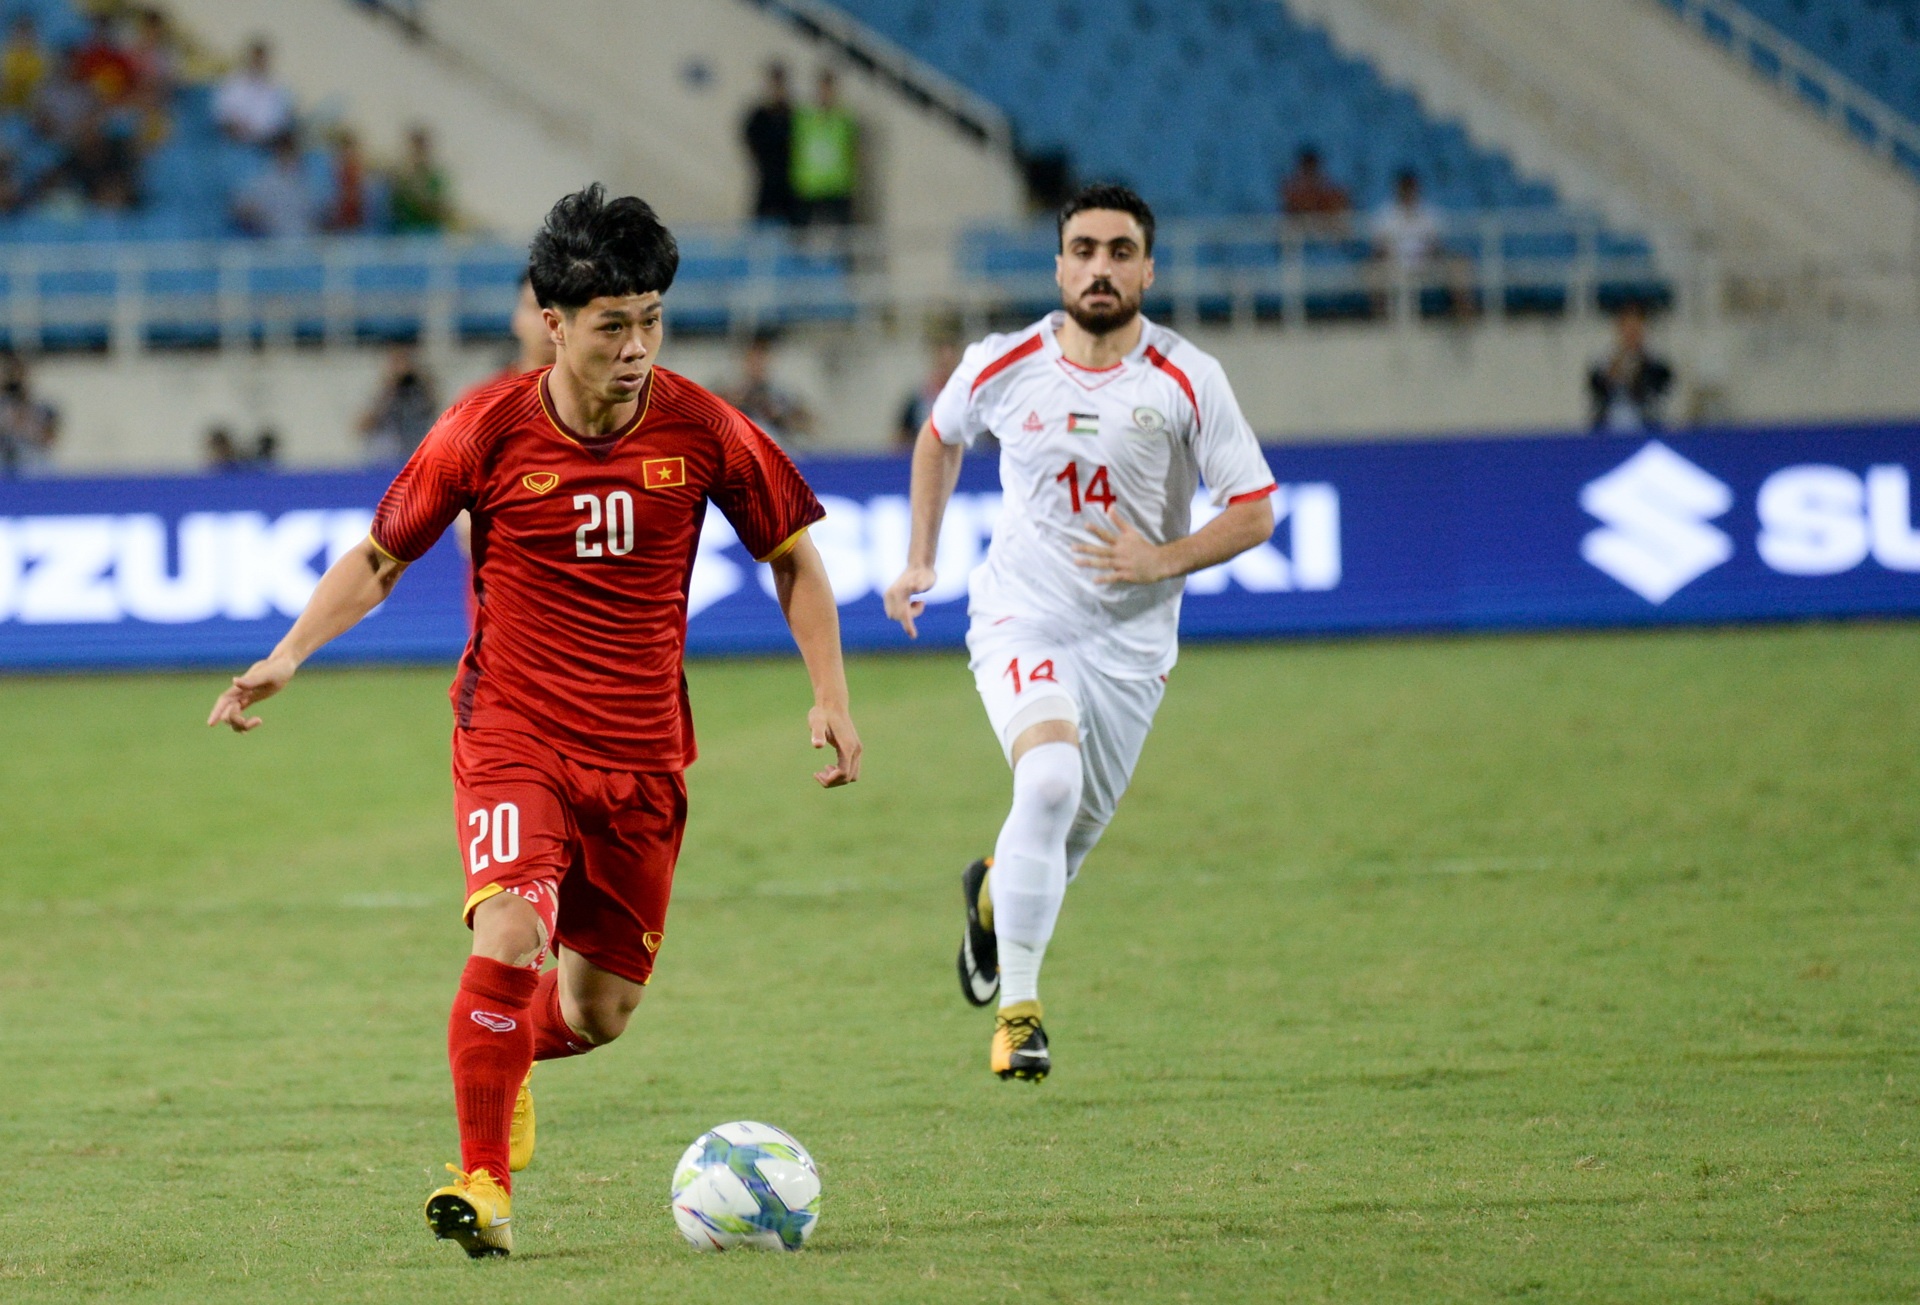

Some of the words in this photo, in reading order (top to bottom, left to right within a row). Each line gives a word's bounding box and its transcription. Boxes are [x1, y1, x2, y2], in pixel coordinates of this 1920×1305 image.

[1056, 461, 1117, 513] 14
[573, 491, 634, 558] 20
[1003, 657, 1058, 695] 14
[468, 802, 519, 875] 20
